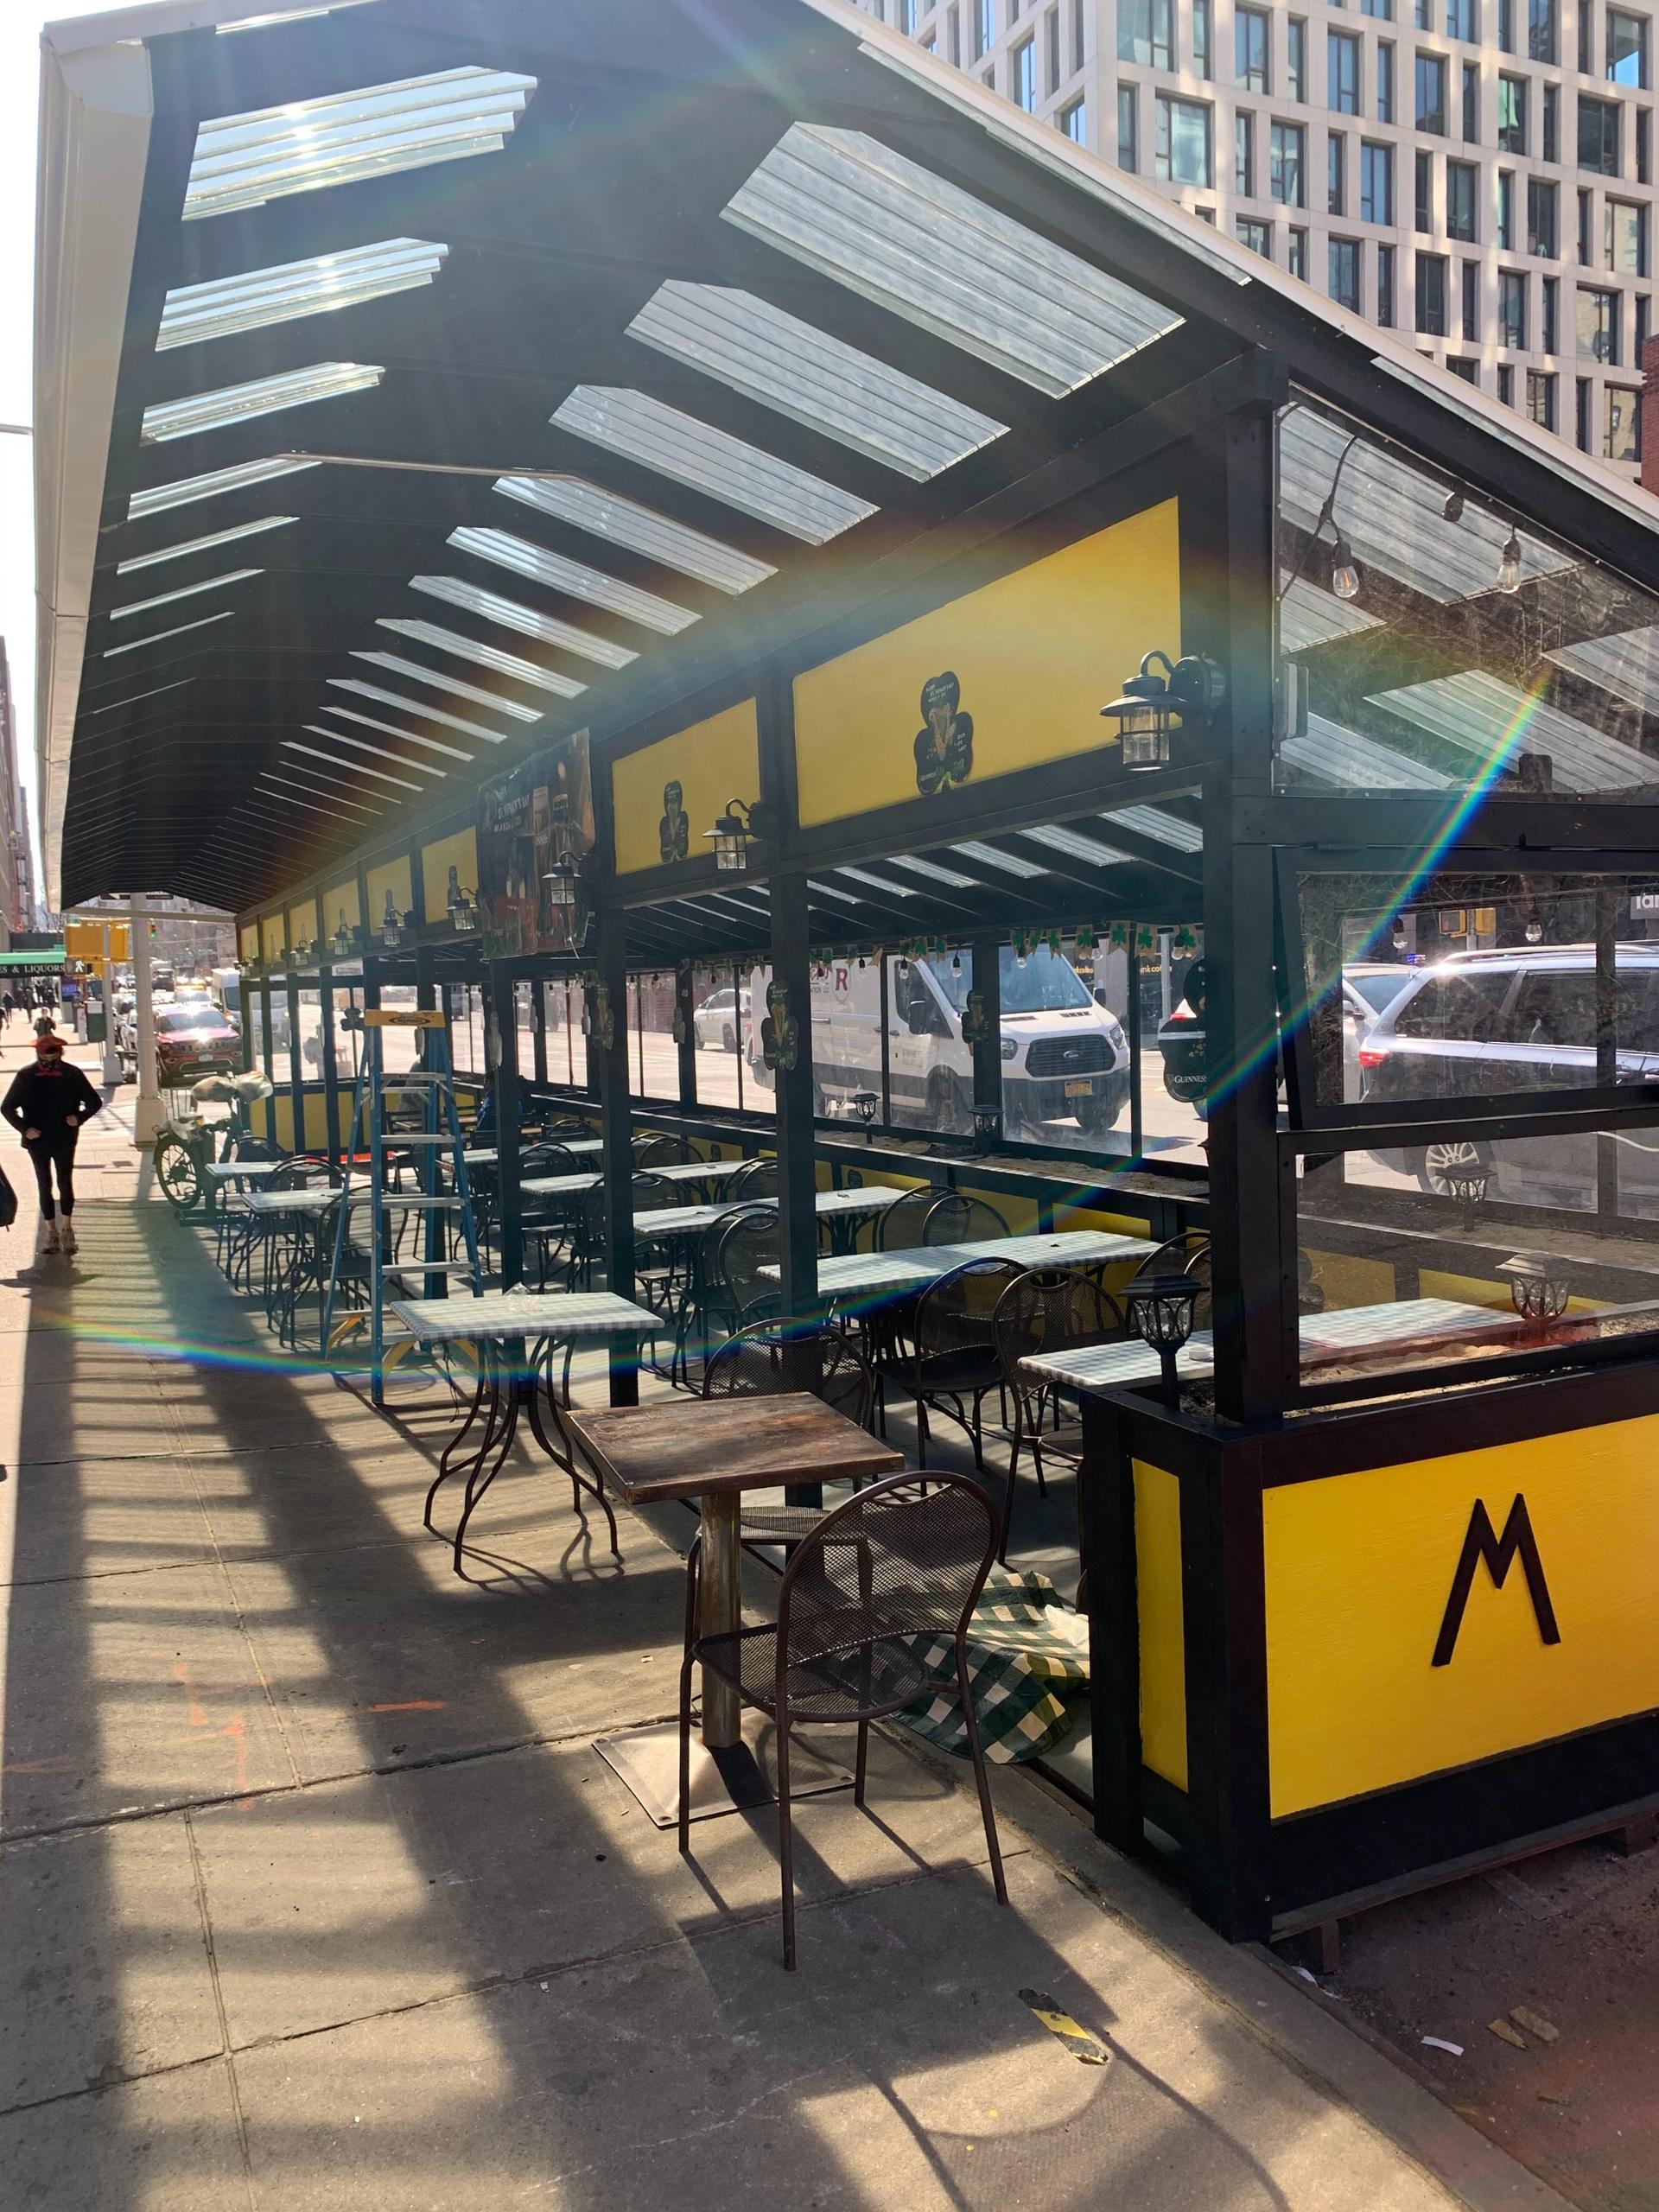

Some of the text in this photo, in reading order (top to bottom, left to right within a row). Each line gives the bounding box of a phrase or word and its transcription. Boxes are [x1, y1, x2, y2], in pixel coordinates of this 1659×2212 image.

[24, 964, 66, 975] LIQUORS
[835, 968, 849, 991] R
[1431, 1492, 1561, 1668] M
